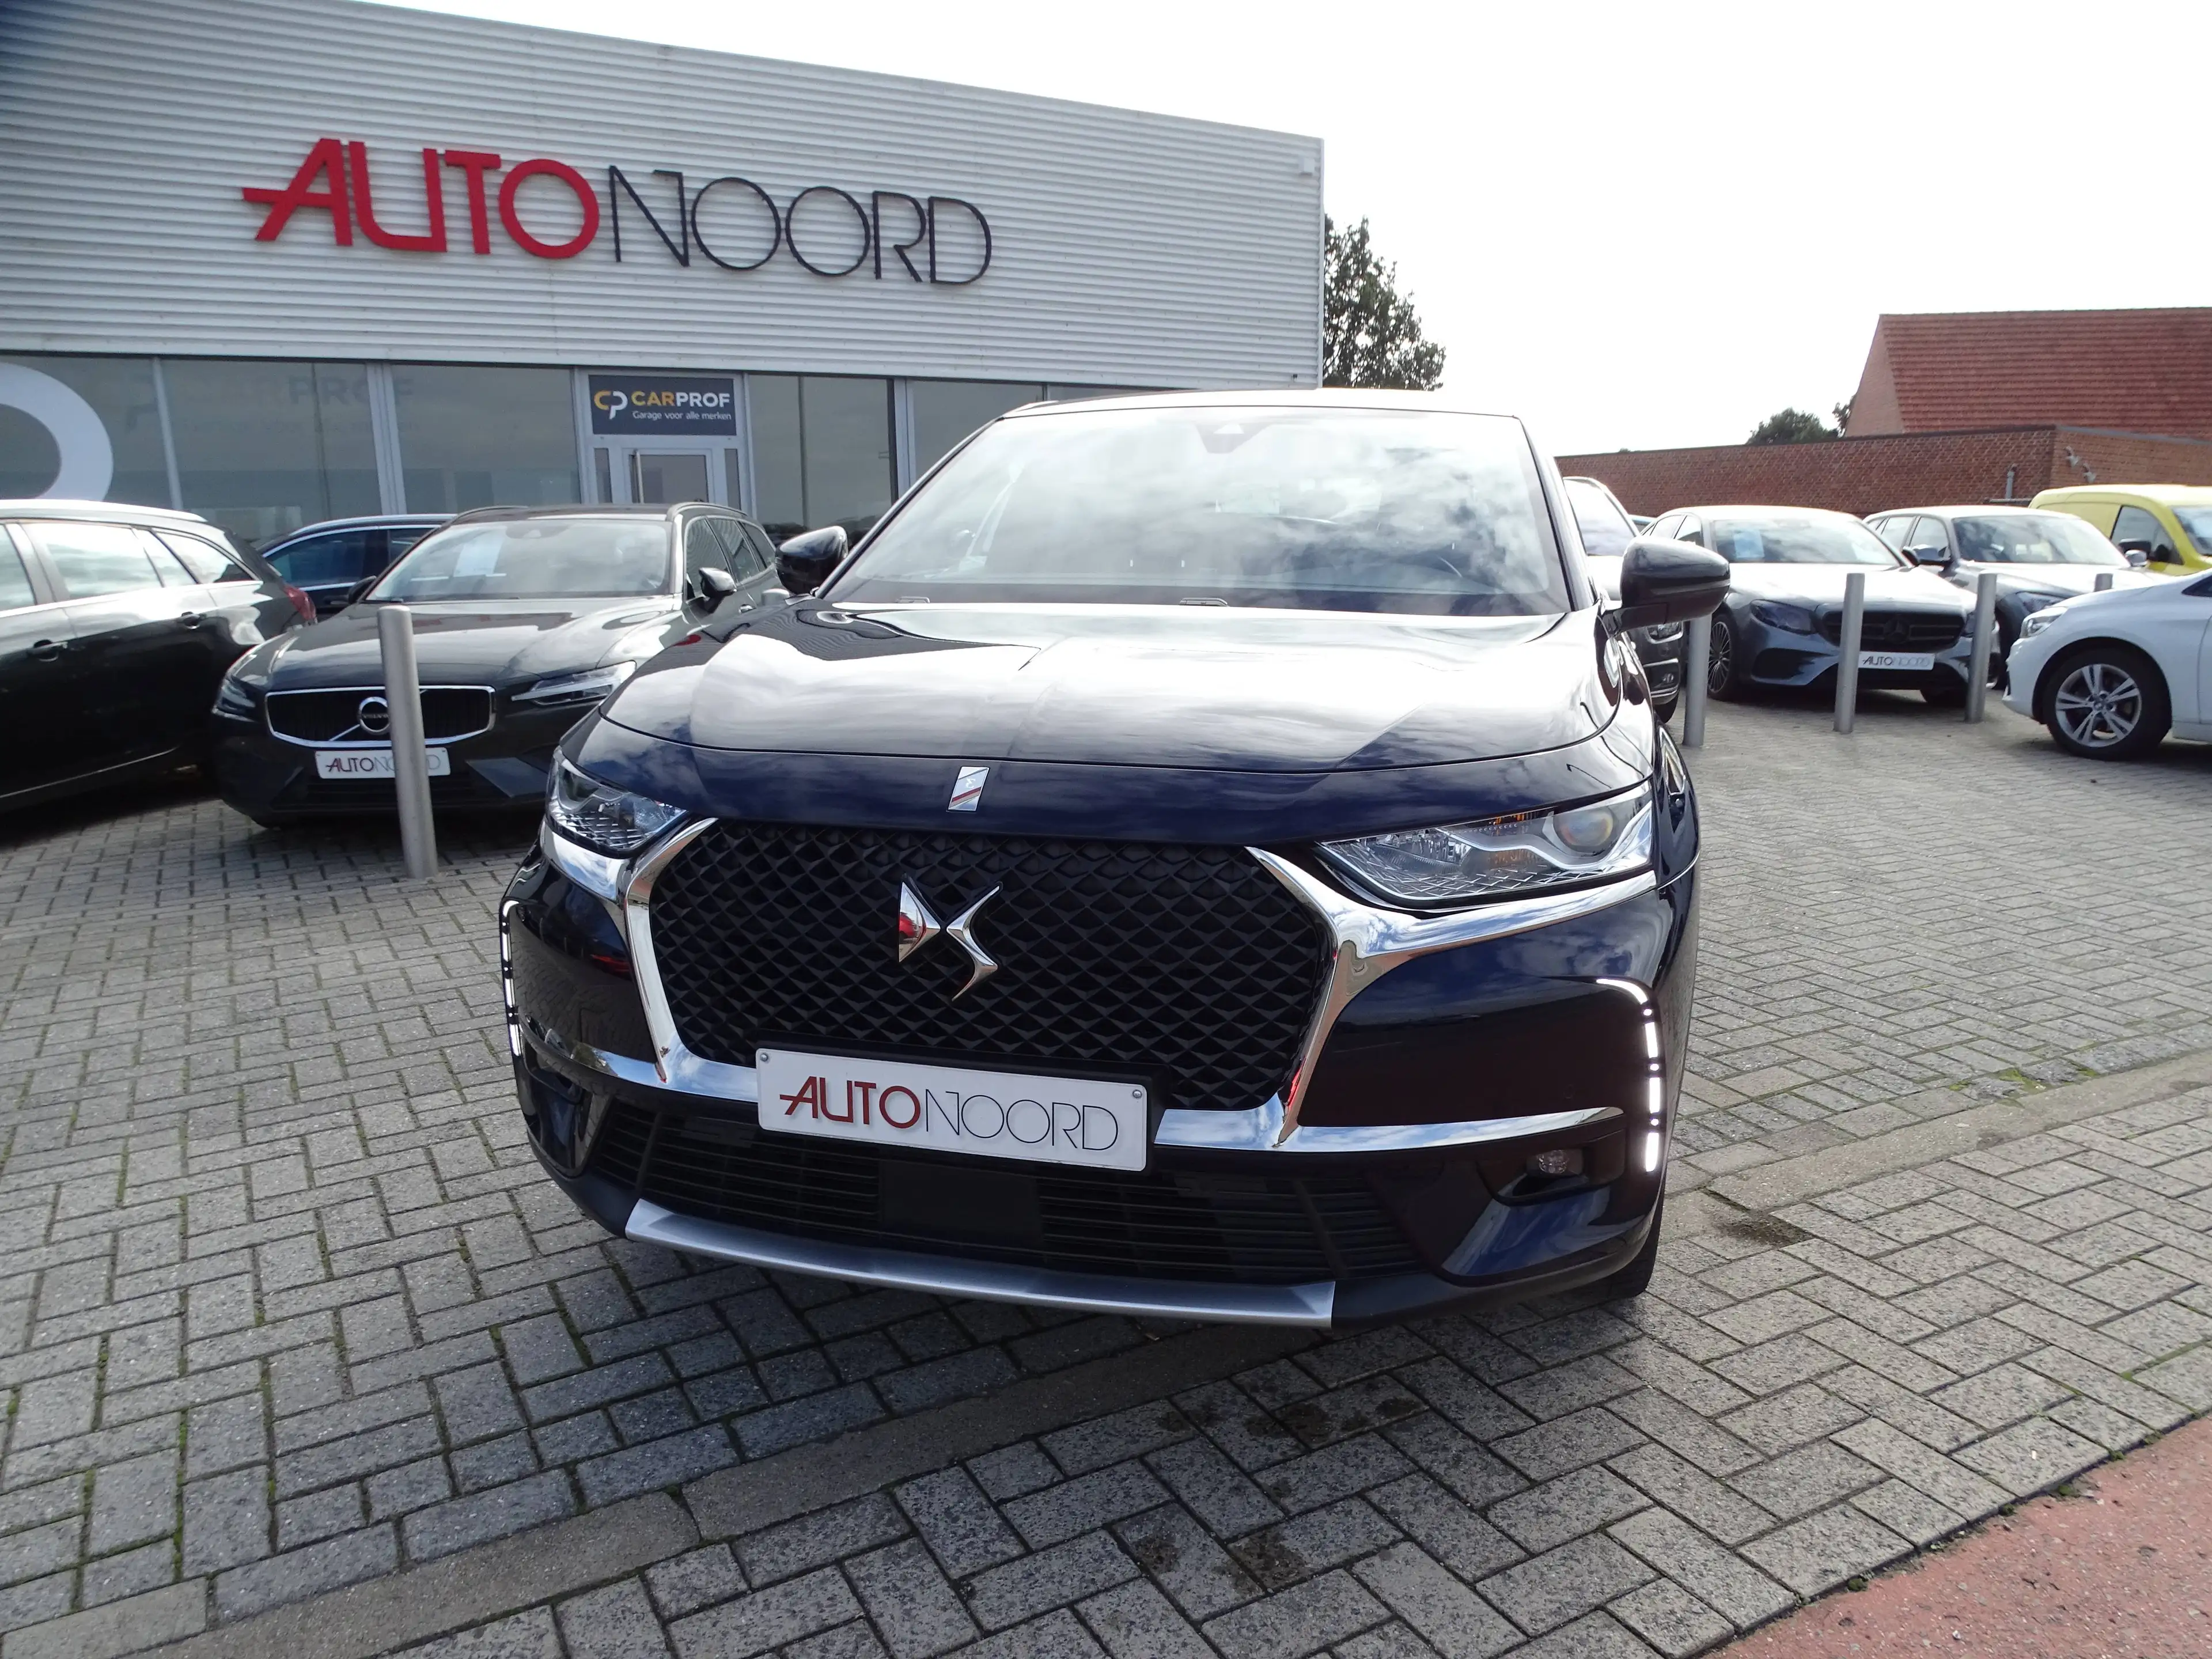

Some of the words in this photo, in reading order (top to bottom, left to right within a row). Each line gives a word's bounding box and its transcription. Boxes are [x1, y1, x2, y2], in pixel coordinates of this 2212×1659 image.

[631, 391, 730, 407] CARPROF
[632, 410, 662, 421] Garage
[685, 411, 700, 419] alle
[702, 411, 732, 420] merken
